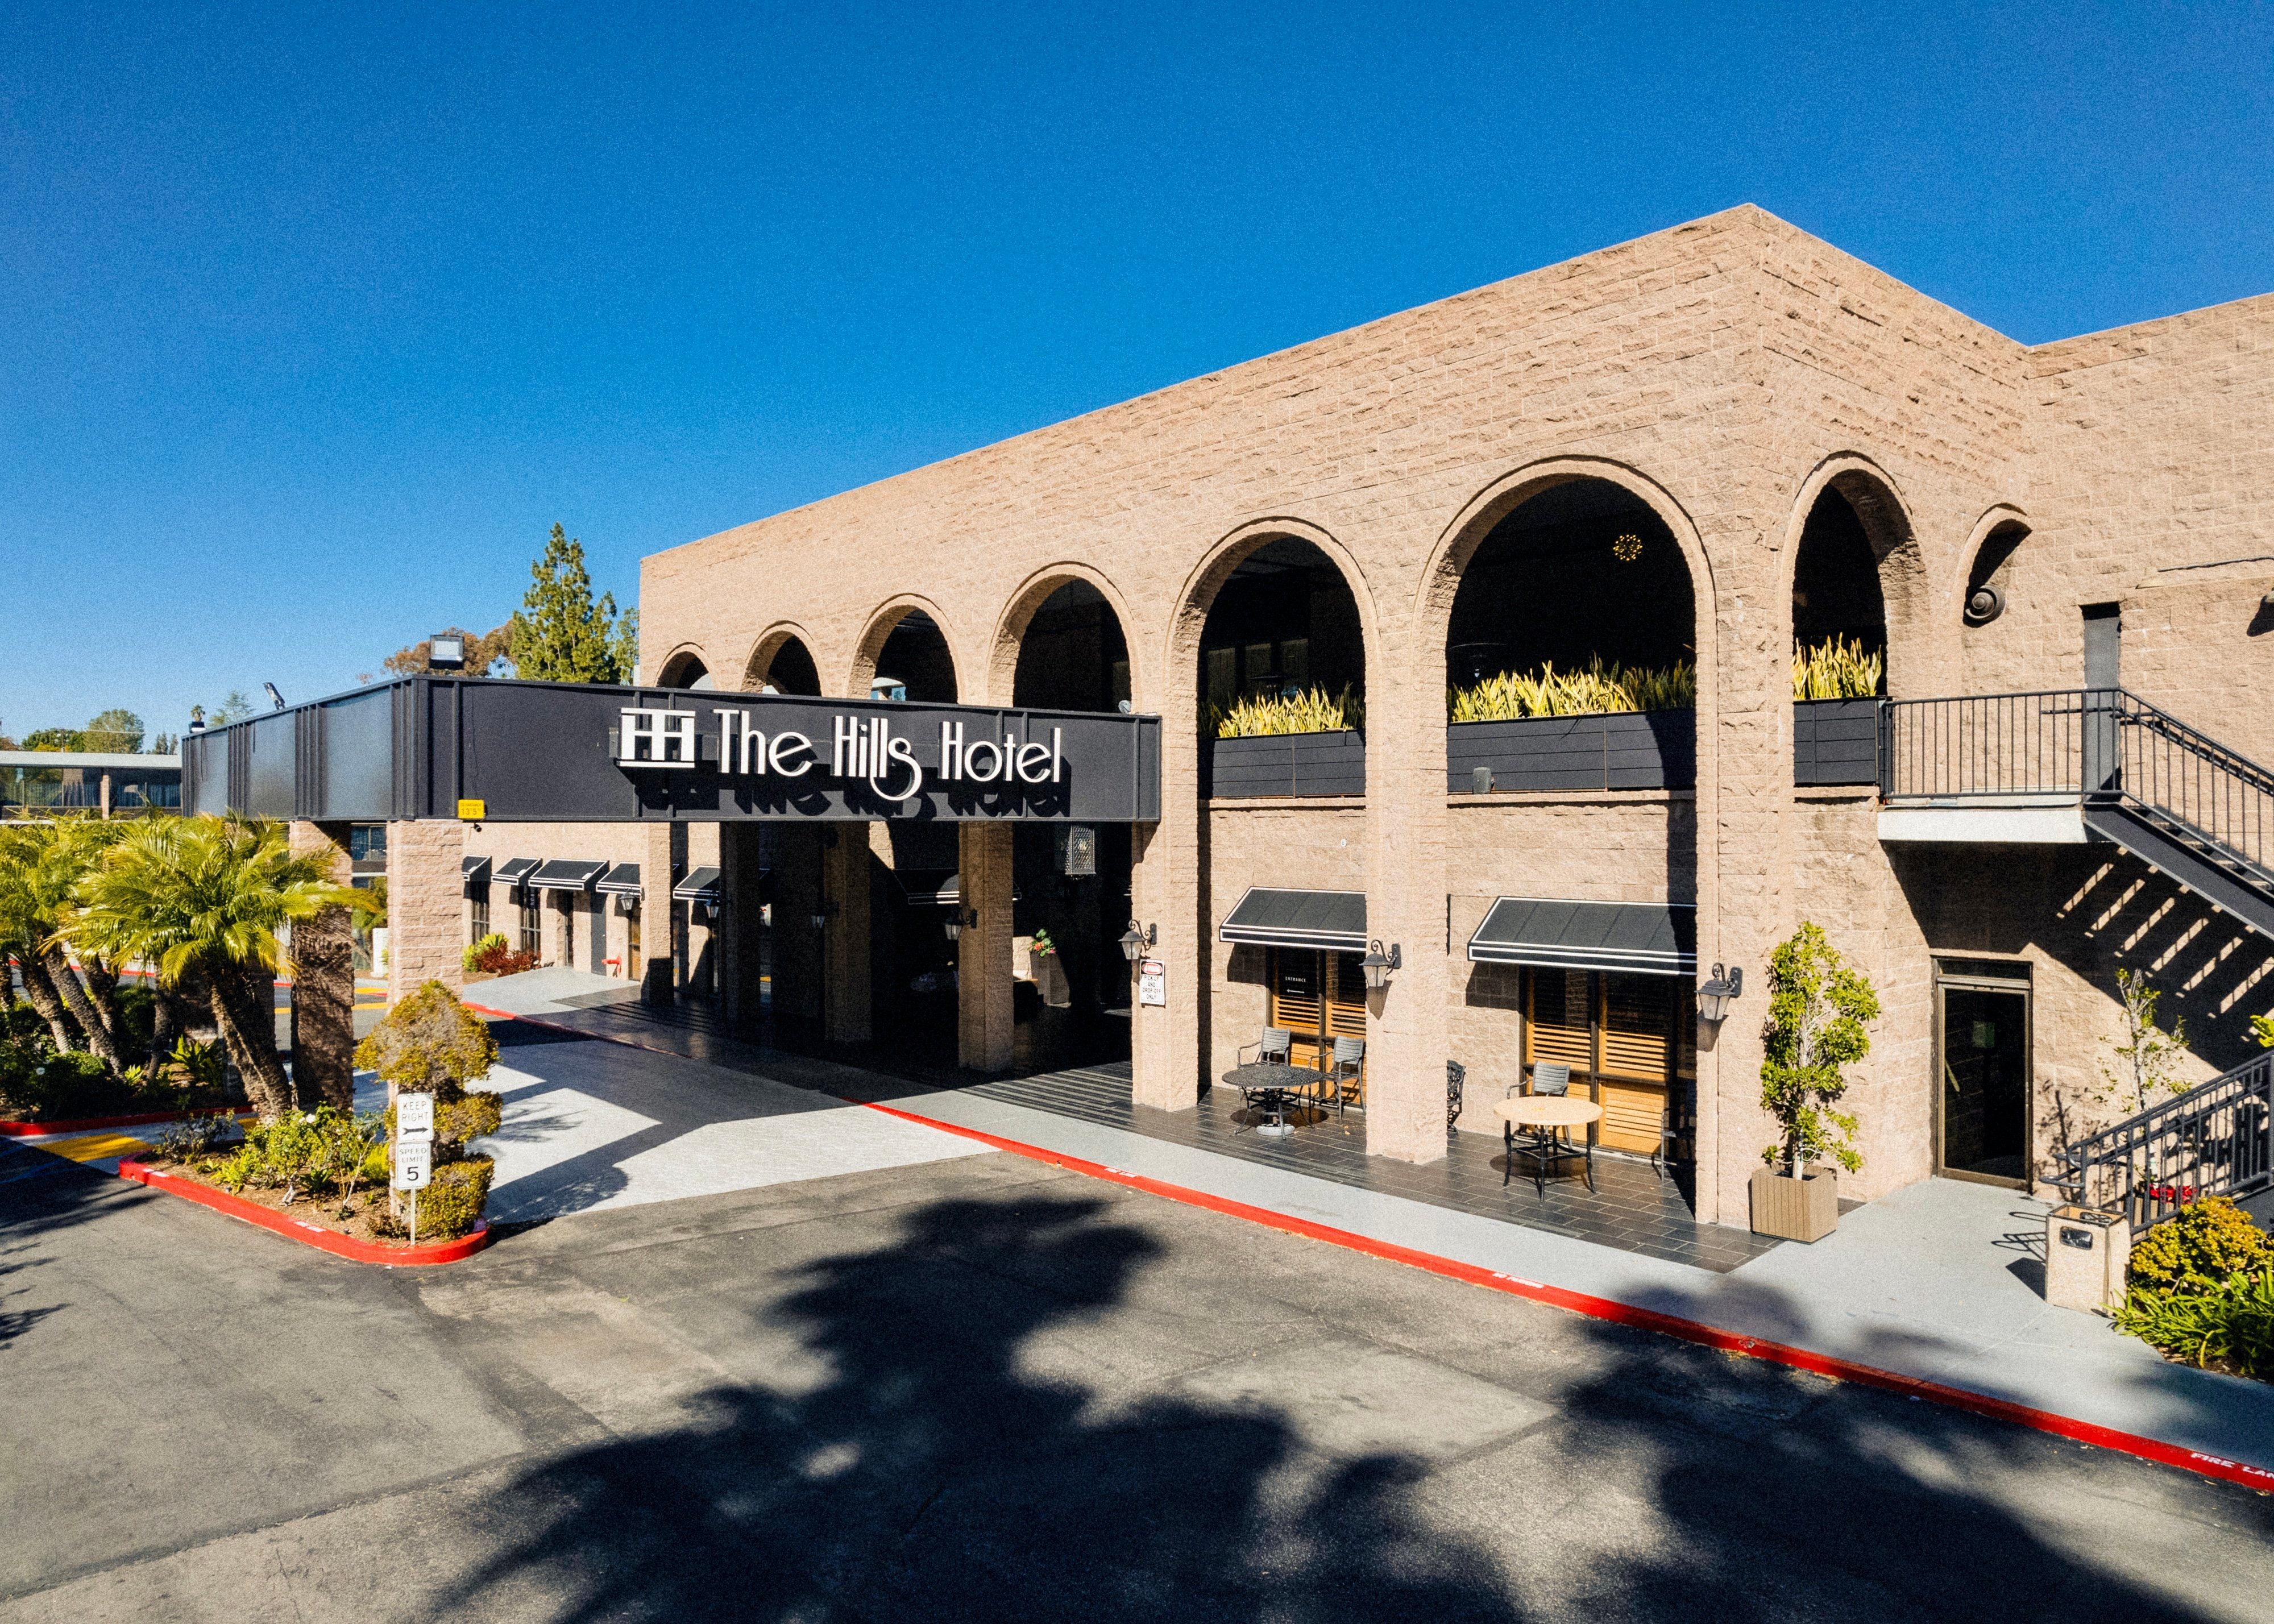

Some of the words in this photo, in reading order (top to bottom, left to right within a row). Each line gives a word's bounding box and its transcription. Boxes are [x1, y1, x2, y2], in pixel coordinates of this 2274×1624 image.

[713, 708, 813, 778] The
[833, 715, 923, 801] Hills
[940, 721, 1061, 783] Hotel
[403, 1100, 427, 1111] KEEP
[401, 1112, 428, 1122] RIGHT
[406, 1166, 419, 1181] 5
[2190, 1452, 2235, 1468] FIRE
